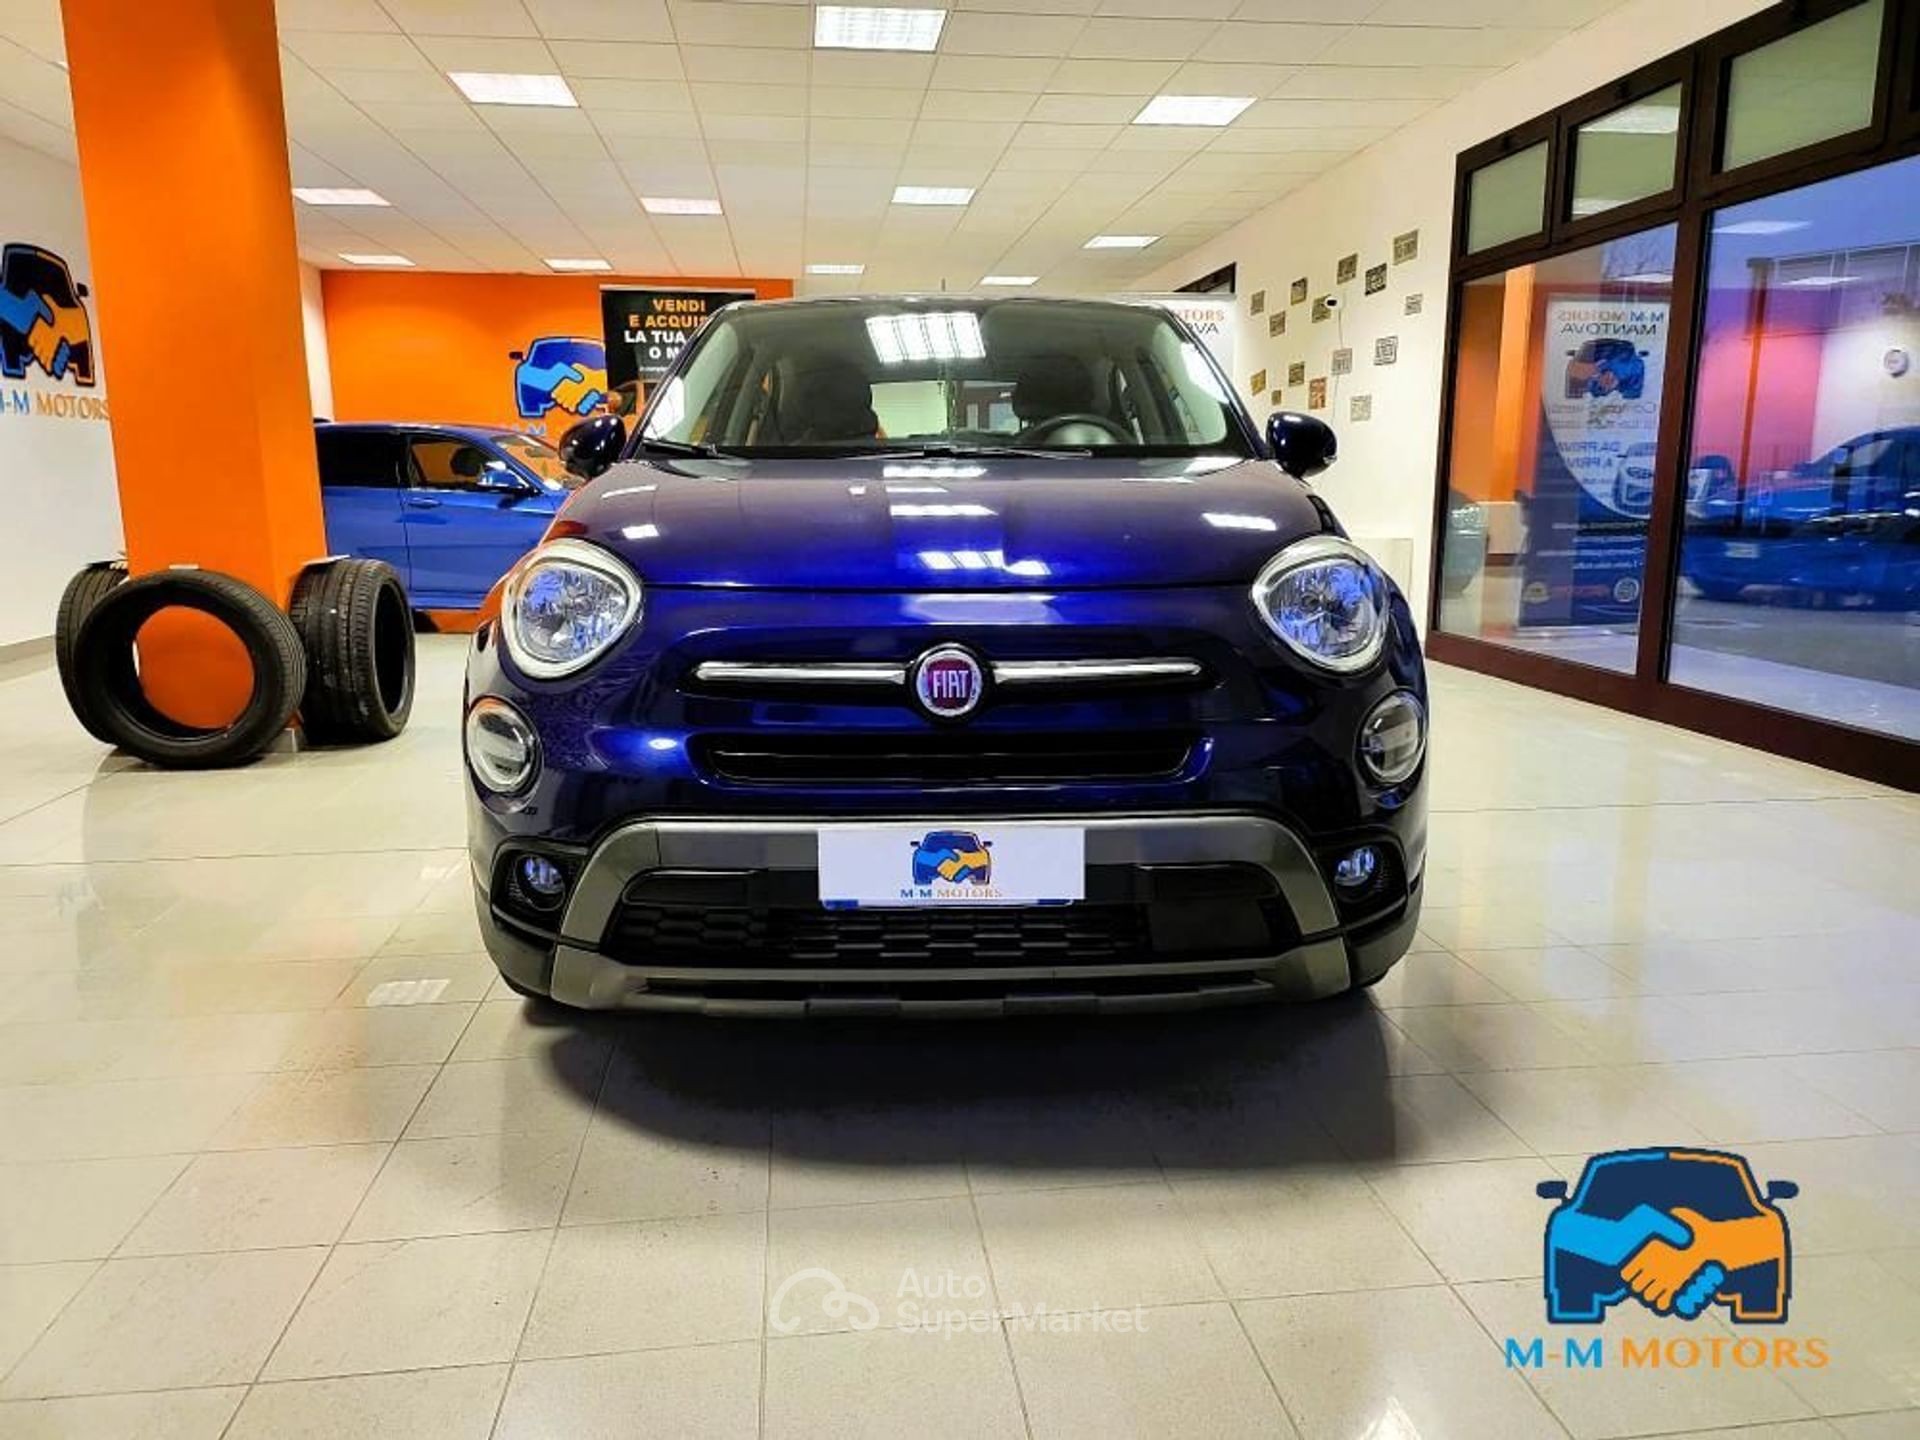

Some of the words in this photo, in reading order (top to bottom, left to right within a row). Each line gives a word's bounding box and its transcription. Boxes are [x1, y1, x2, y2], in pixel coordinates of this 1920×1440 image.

[652, 299, 706, 312] VENDI
[629, 314, 640, 328] E
[624, 331, 647, 343] LA
[651, 331, 687, 343] TUA
[649, 347, 661, 359] O
[932, 670, 969, 698] FIAT
[900, 888, 933, 898] M-M
[936, 888, 1003, 898] MOTORS
